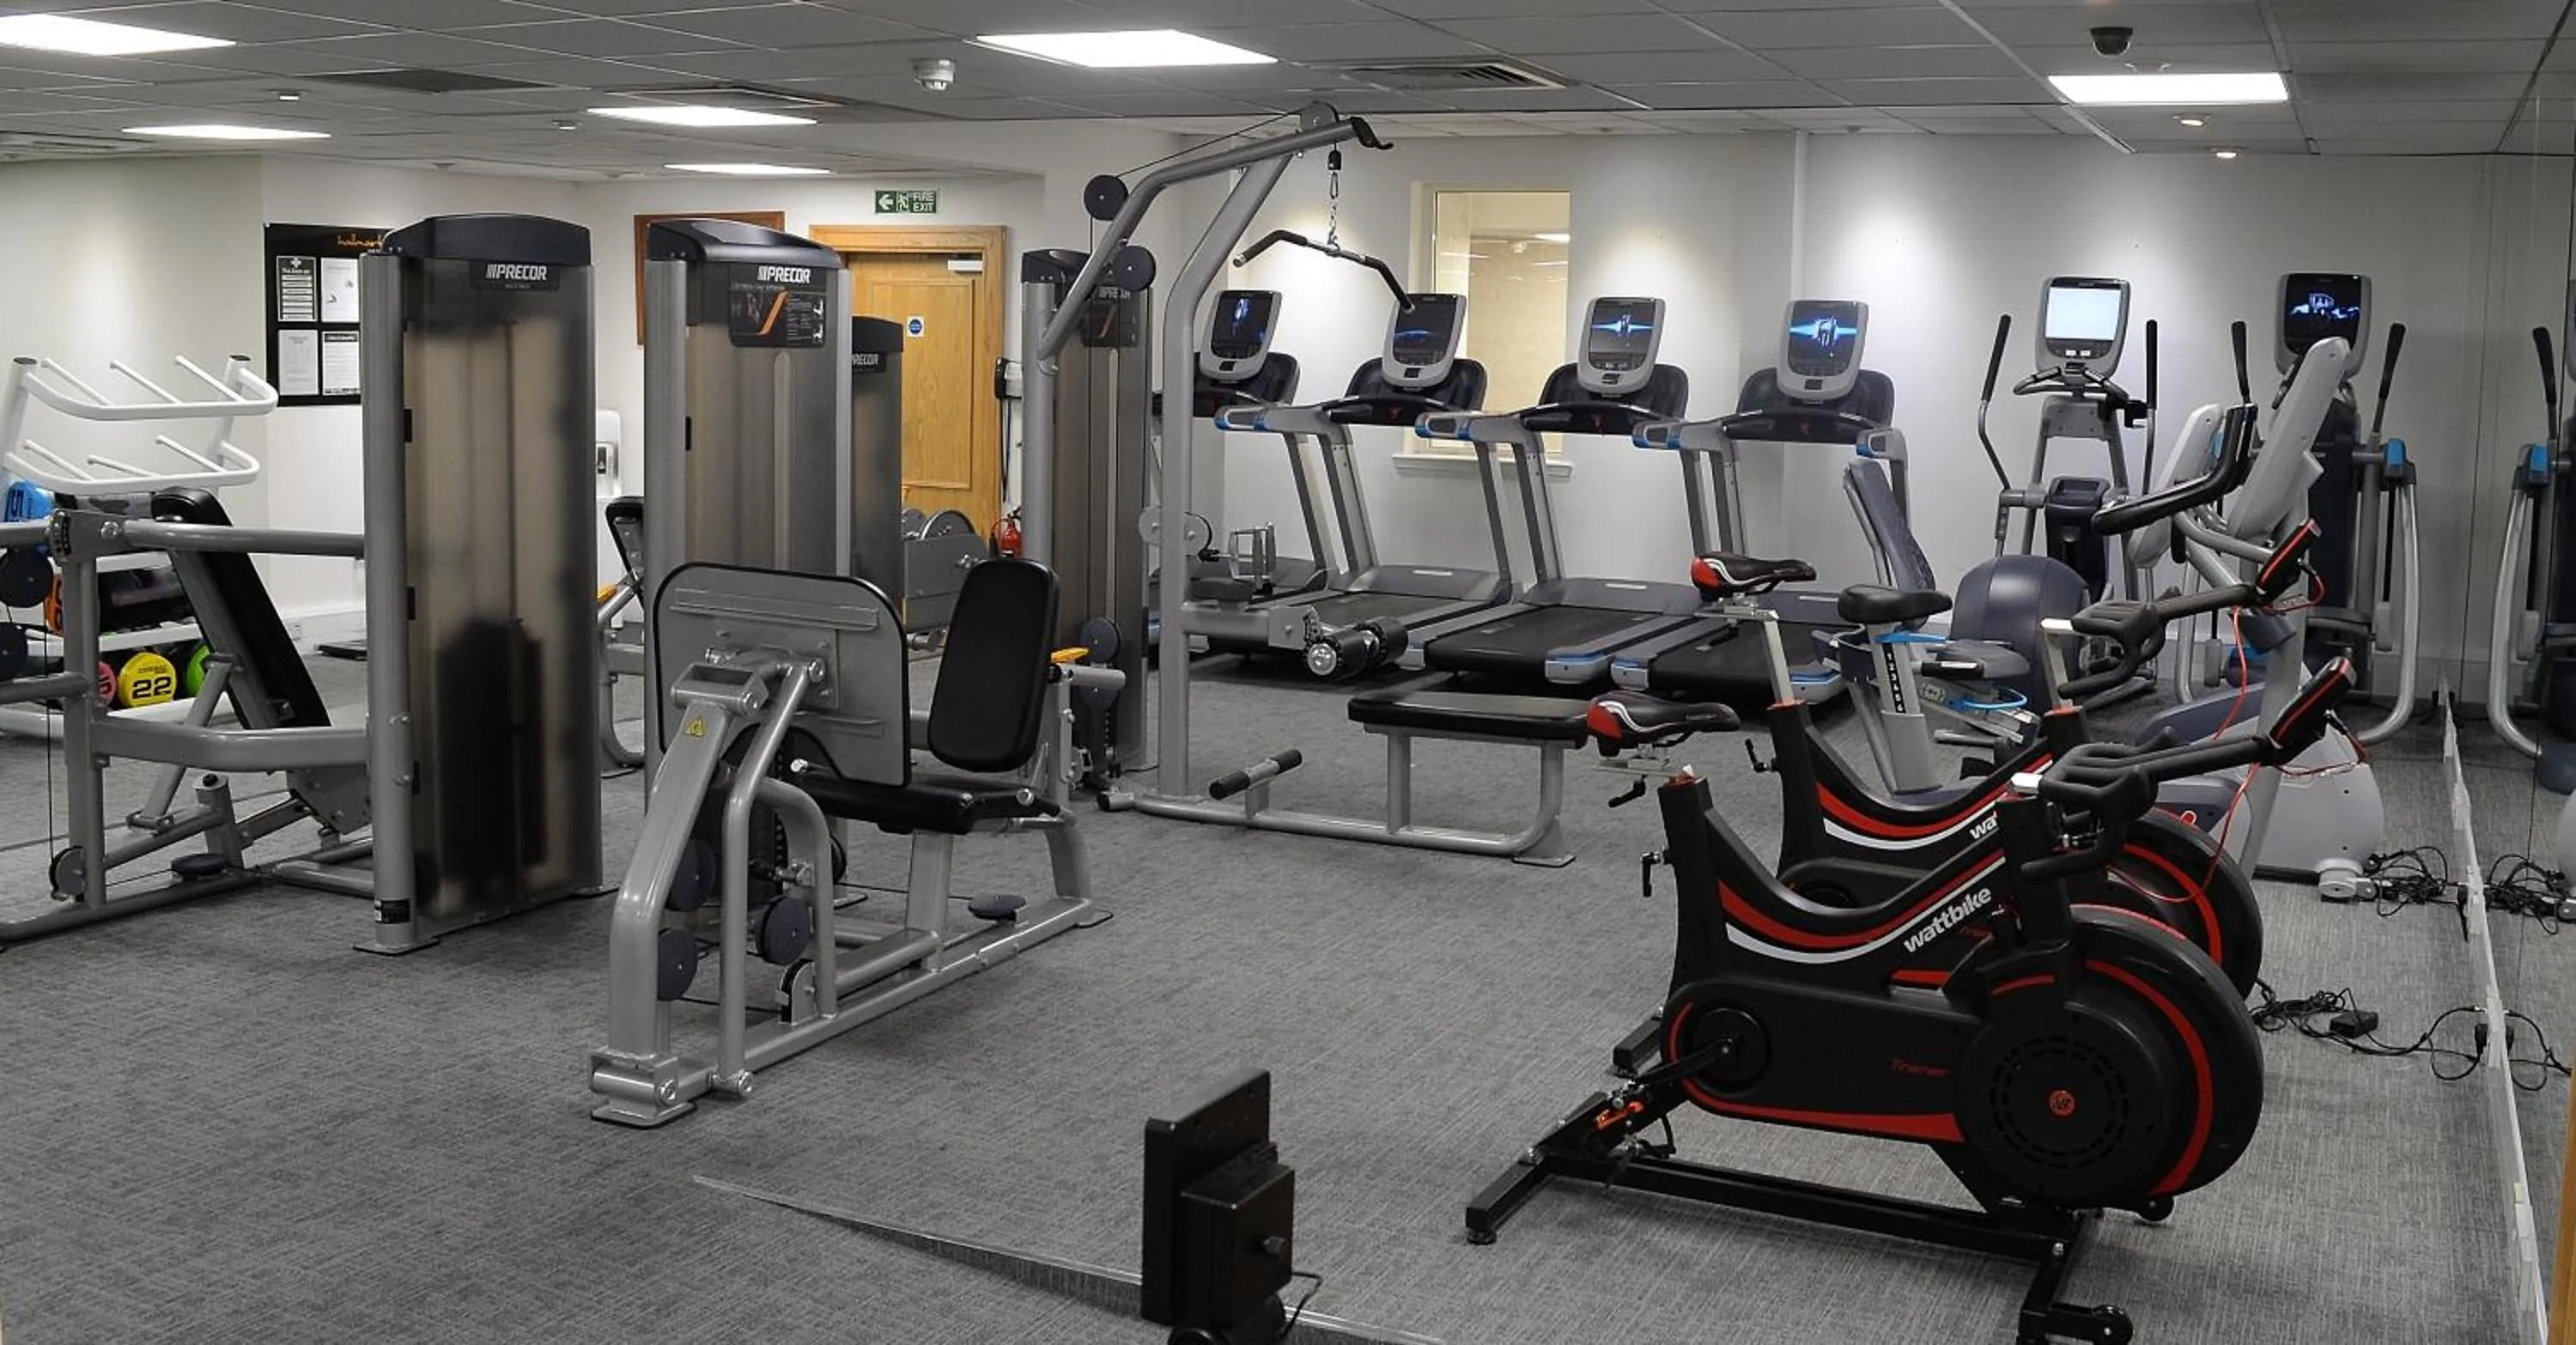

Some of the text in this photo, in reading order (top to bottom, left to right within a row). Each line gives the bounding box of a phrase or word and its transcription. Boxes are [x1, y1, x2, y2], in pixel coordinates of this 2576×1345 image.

[913, 192, 935, 202] FIRE
[913, 202, 934, 212] EXIT
[496, 264, 548, 281] PRECOR
[767, 266, 811, 284] PRECOR
[132, 676, 172, 699] 22
[1904, 887, 1992, 952] wattbike
